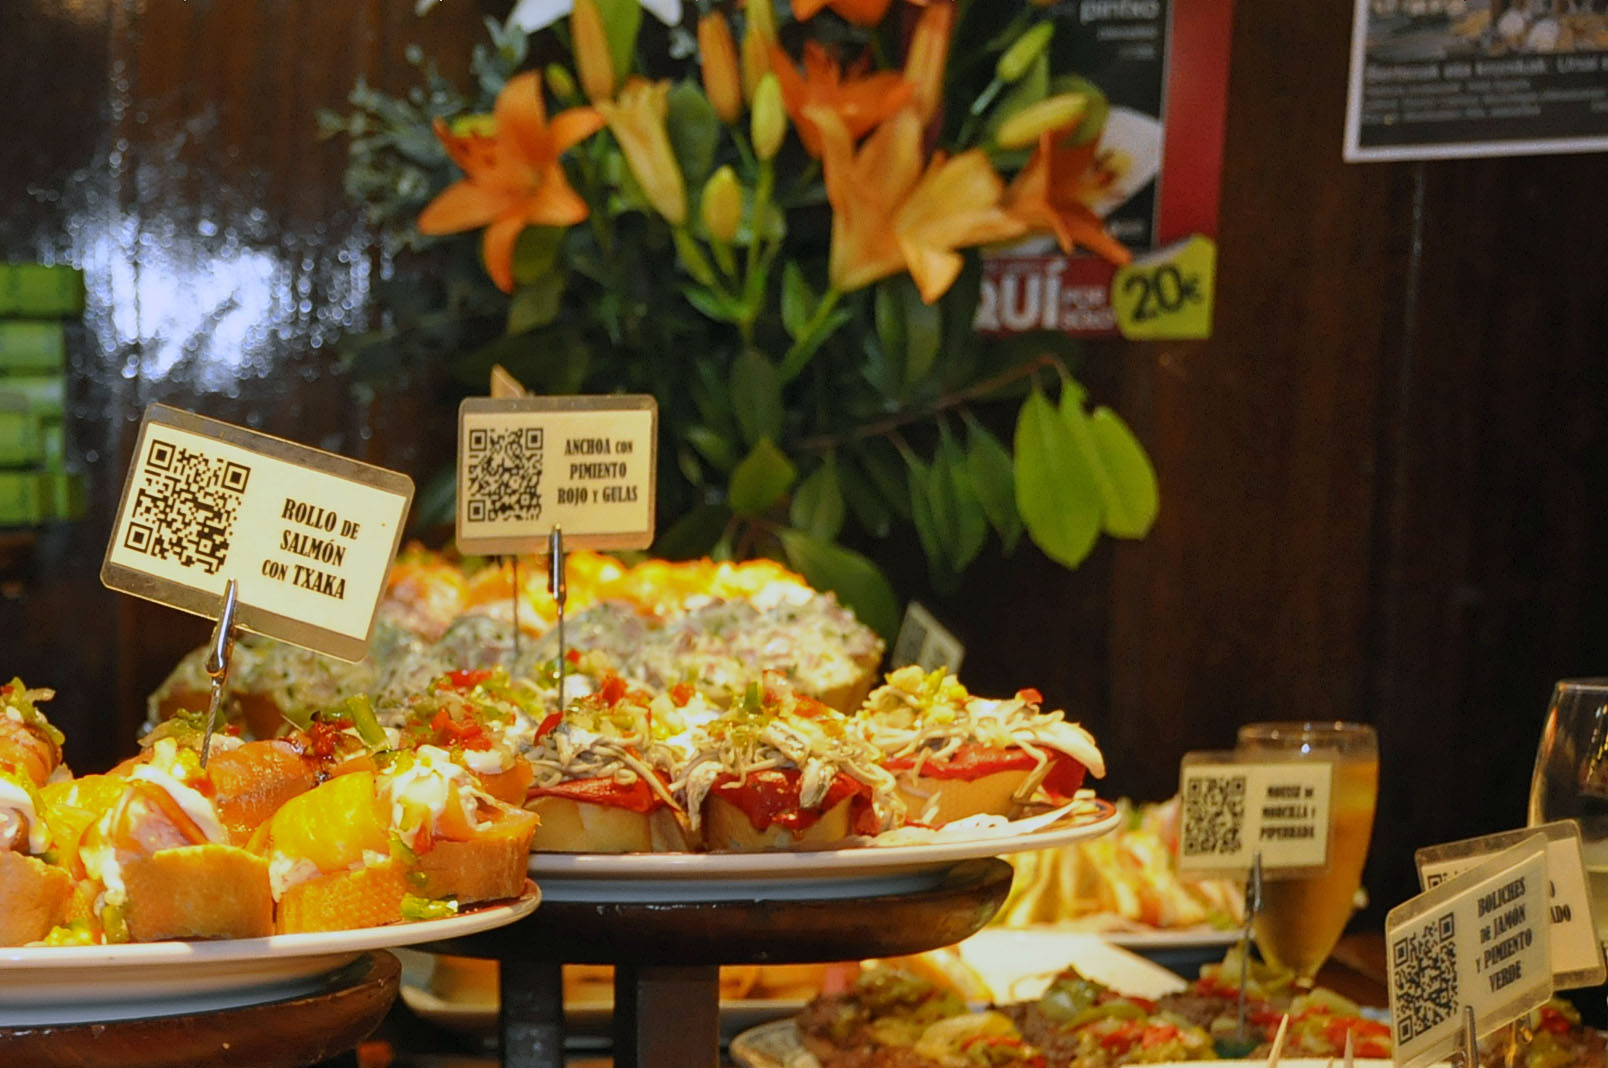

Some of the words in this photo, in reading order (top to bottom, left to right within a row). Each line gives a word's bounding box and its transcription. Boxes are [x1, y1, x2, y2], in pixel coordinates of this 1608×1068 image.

[564, 437, 611, 455] ANCHOA
[569, 462, 627, 480] PIMIENTO
[556, 487, 588, 506] ROJO
[602, 485, 638, 503] GULAS
[281, 497, 337, 533] ROLLO
[340, 519, 361, 540] DE
[279, 529, 347, 567] SALMÓN
[261, 559, 289, 582] CON
[292, 564, 346, 600] TXAKA
[1477, 876, 1526, 917] BOLICHES
[1480, 925, 1492, 944] DE
[1484, 927, 1533, 970] PIMIENTO
[1489, 960, 1523, 993] VERDE
